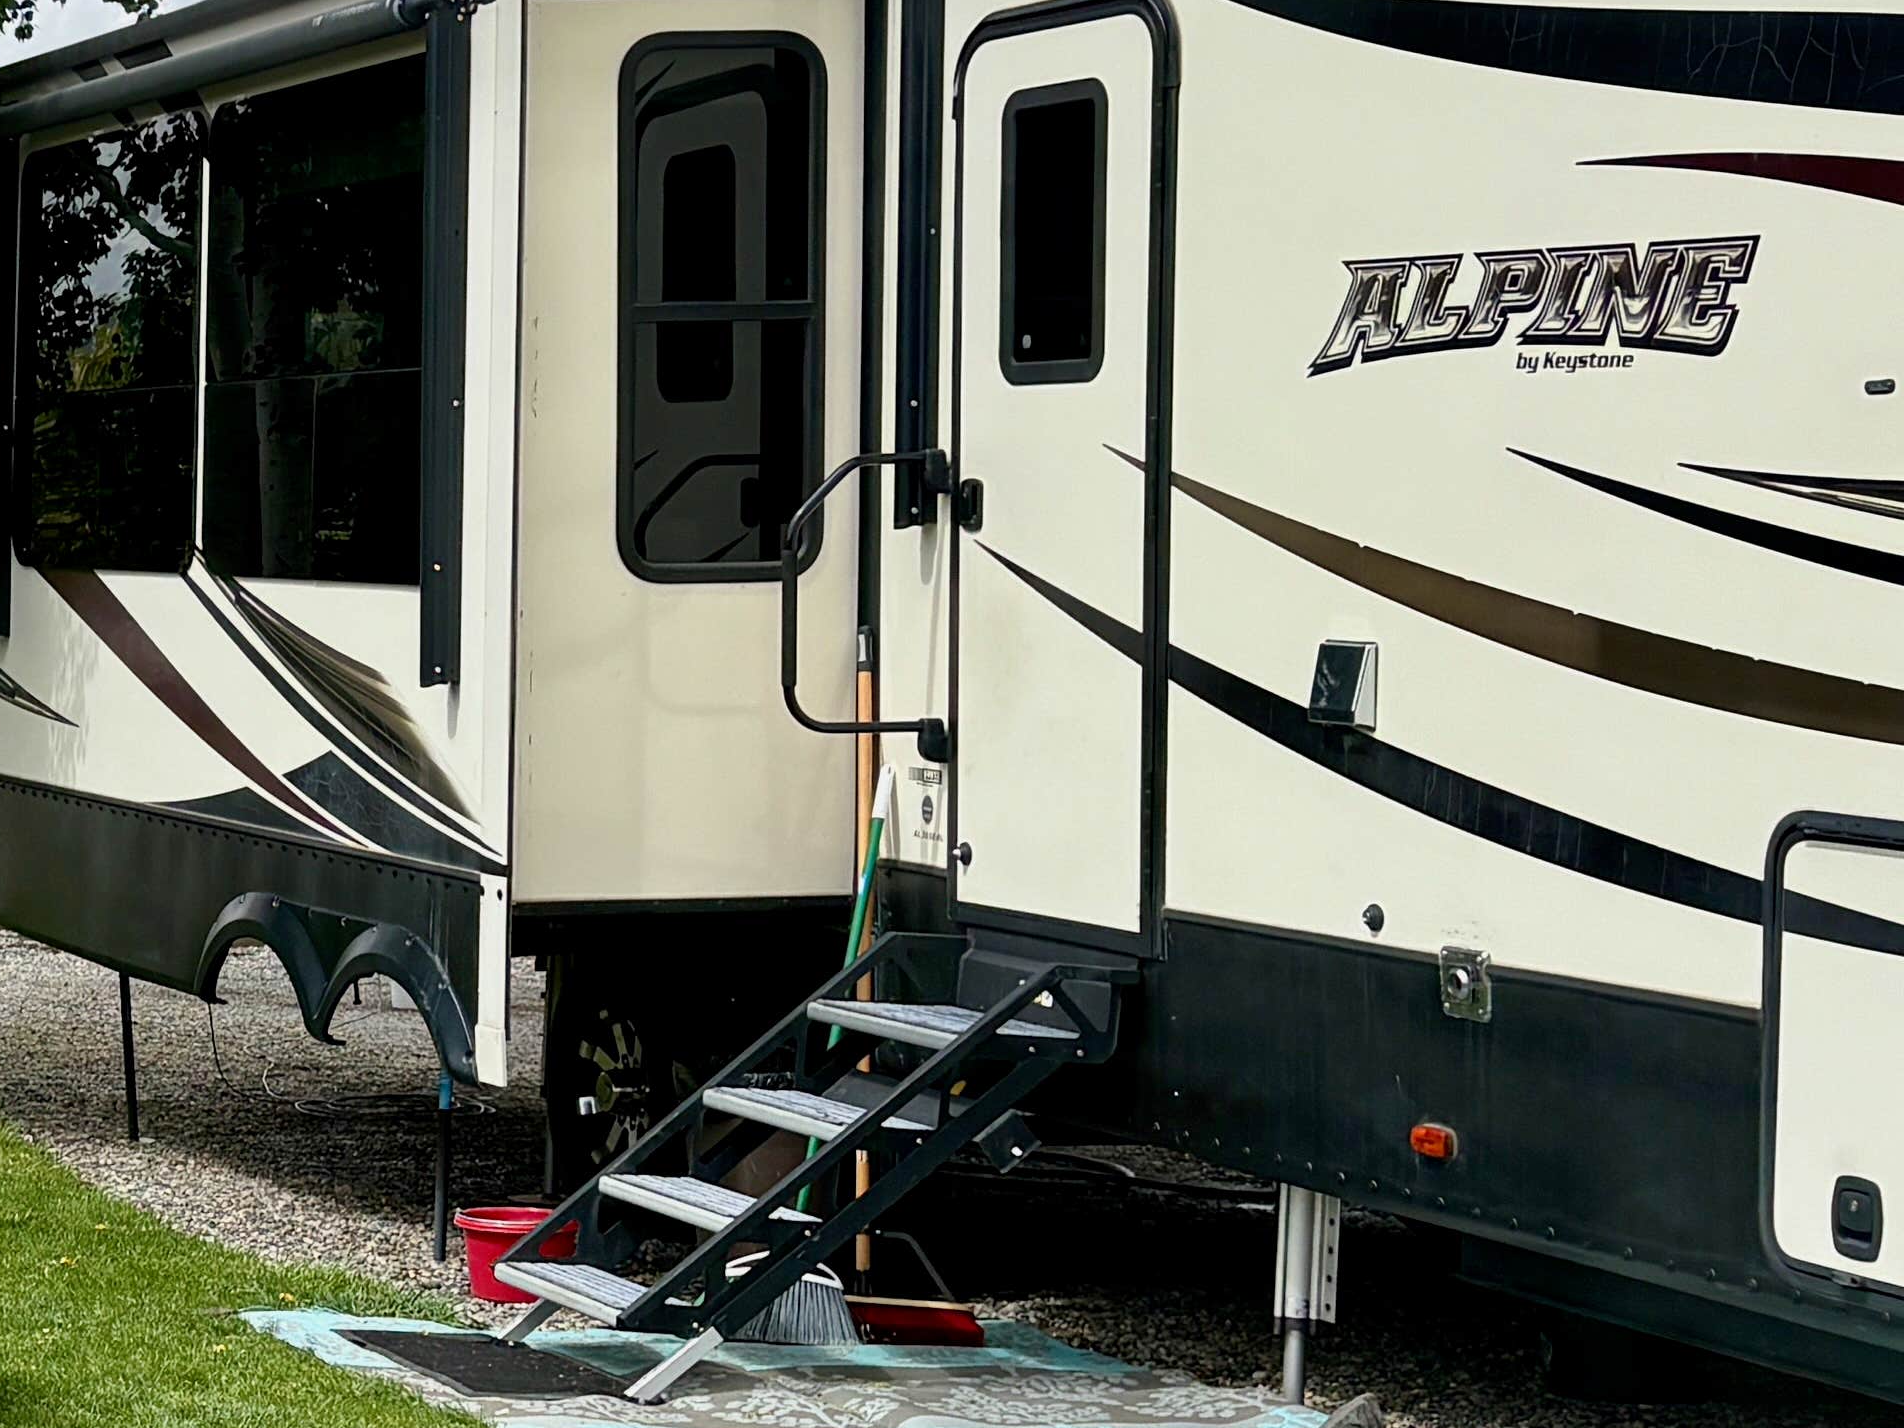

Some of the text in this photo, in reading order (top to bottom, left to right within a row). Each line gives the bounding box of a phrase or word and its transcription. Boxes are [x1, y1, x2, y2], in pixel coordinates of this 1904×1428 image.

[1305, 234, 1762, 378] ALPINE
[1515, 351, 1635, 374] by Keystone
